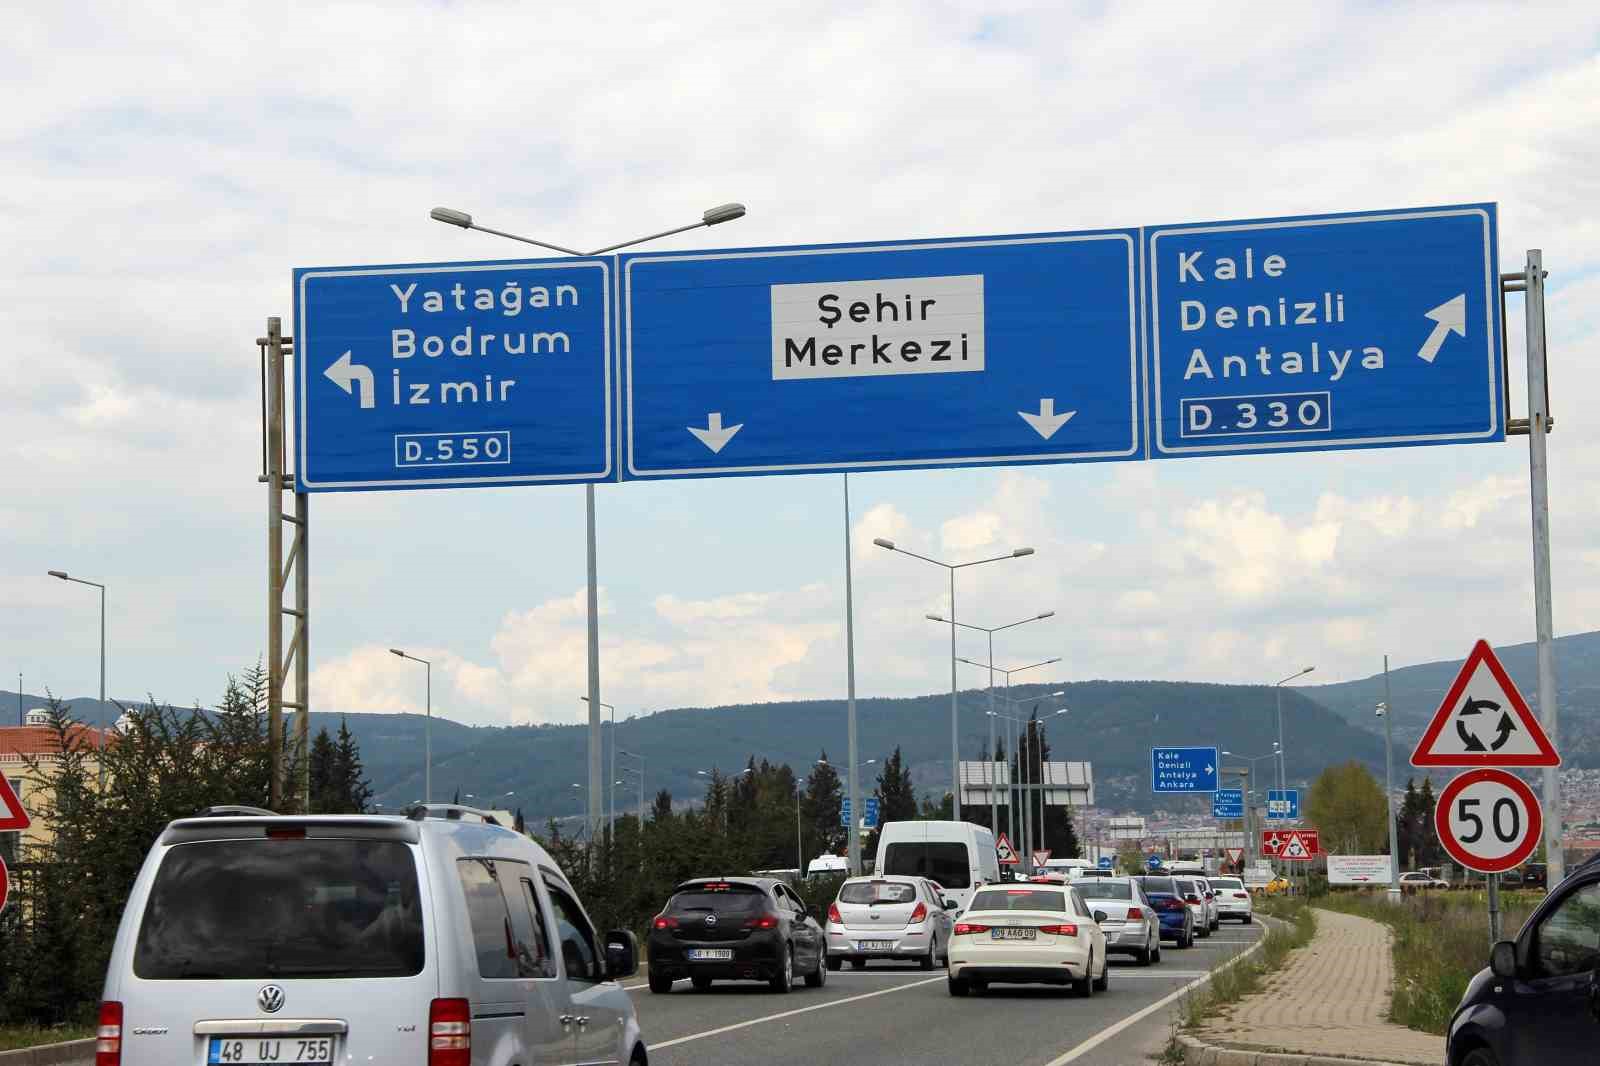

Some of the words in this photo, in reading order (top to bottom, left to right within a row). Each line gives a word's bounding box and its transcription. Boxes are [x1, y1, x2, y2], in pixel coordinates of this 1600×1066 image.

[1179, 248, 1287, 283] Kale
[389, 281, 579, 317] Yatağan
[817, 292, 937, 329] Şehir
[1180, 292, 1345, 332] Denizli
[391, 326, 571, 359] Bodrum
[784, 333, 968, 368] Merkezi
[1183, 342, 1384, 381] Antalya
[392, 368, 516, 405] İzmir
[1158, 751, 1180, 760] Kale
[1158, 761, 1191, 769] Denizli
[1160, 771, 1198, 780] Antalya
[1459, 797, 1520, 844] 50
[222, 1041, 243, 1061] 48
[259, 1041, 280, 1060] UJ
[296, 1040, 328, 1060] 755
